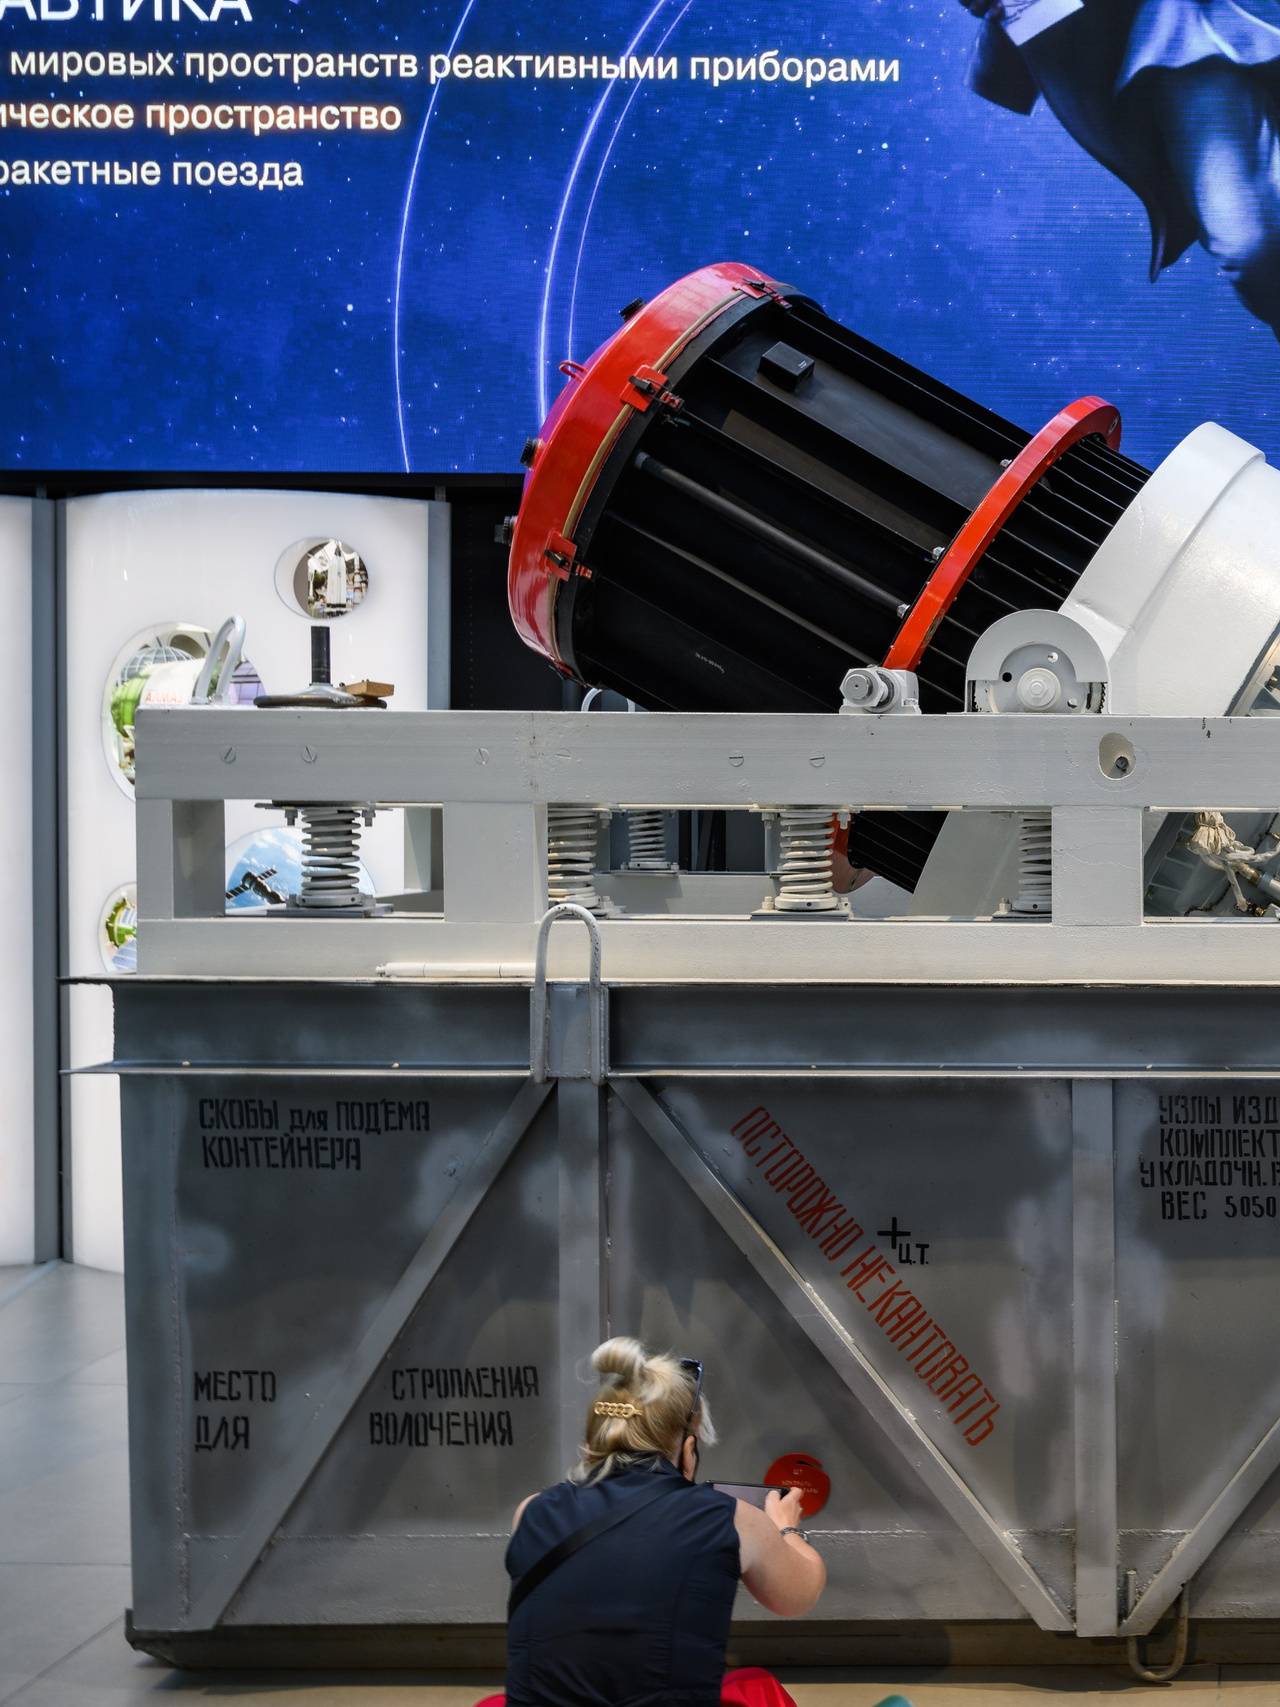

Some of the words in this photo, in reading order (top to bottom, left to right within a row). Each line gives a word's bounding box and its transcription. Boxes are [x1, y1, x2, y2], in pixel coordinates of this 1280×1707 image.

[10, 51, 174, 82] мировых
[186, 51, 418, 83] пространств
[429, 52, 678, 84] реактивными
[690, 50, 900, 87] приборами
[146, 102, 402, 135] пространство
[172, 160, 304, 191] поезда
[199, 1098, 279, 1130] СКОБЫ
[1159, 1095, 1221, 1125] УЗЛЫ
[202, 1133, 361, 1171] КОНТЕЙНЕРА
[1160, 1128, 1280, 1158] КОМПЛЕКТ
[730, 1105, 865, 1262] ОСТОРОЖНО
[1161, 1191, 1207, 1220] ВЕС
[1223, 1195, 1277, 1219] 5050
[840, 1244, 896, 1304] НЕ
[867, 1279, 1001, 1446] КАНТОВАТЬ
[193, 1370, 277, 1403] МЕСТО
[391, 1366, 540, 1400] СТРОПЛЕНИЯ
[195, 1416, 250, 1452] ДЛЯ
[369, 1411, 514, 1446] ВОЛОЧЕНИЯ
